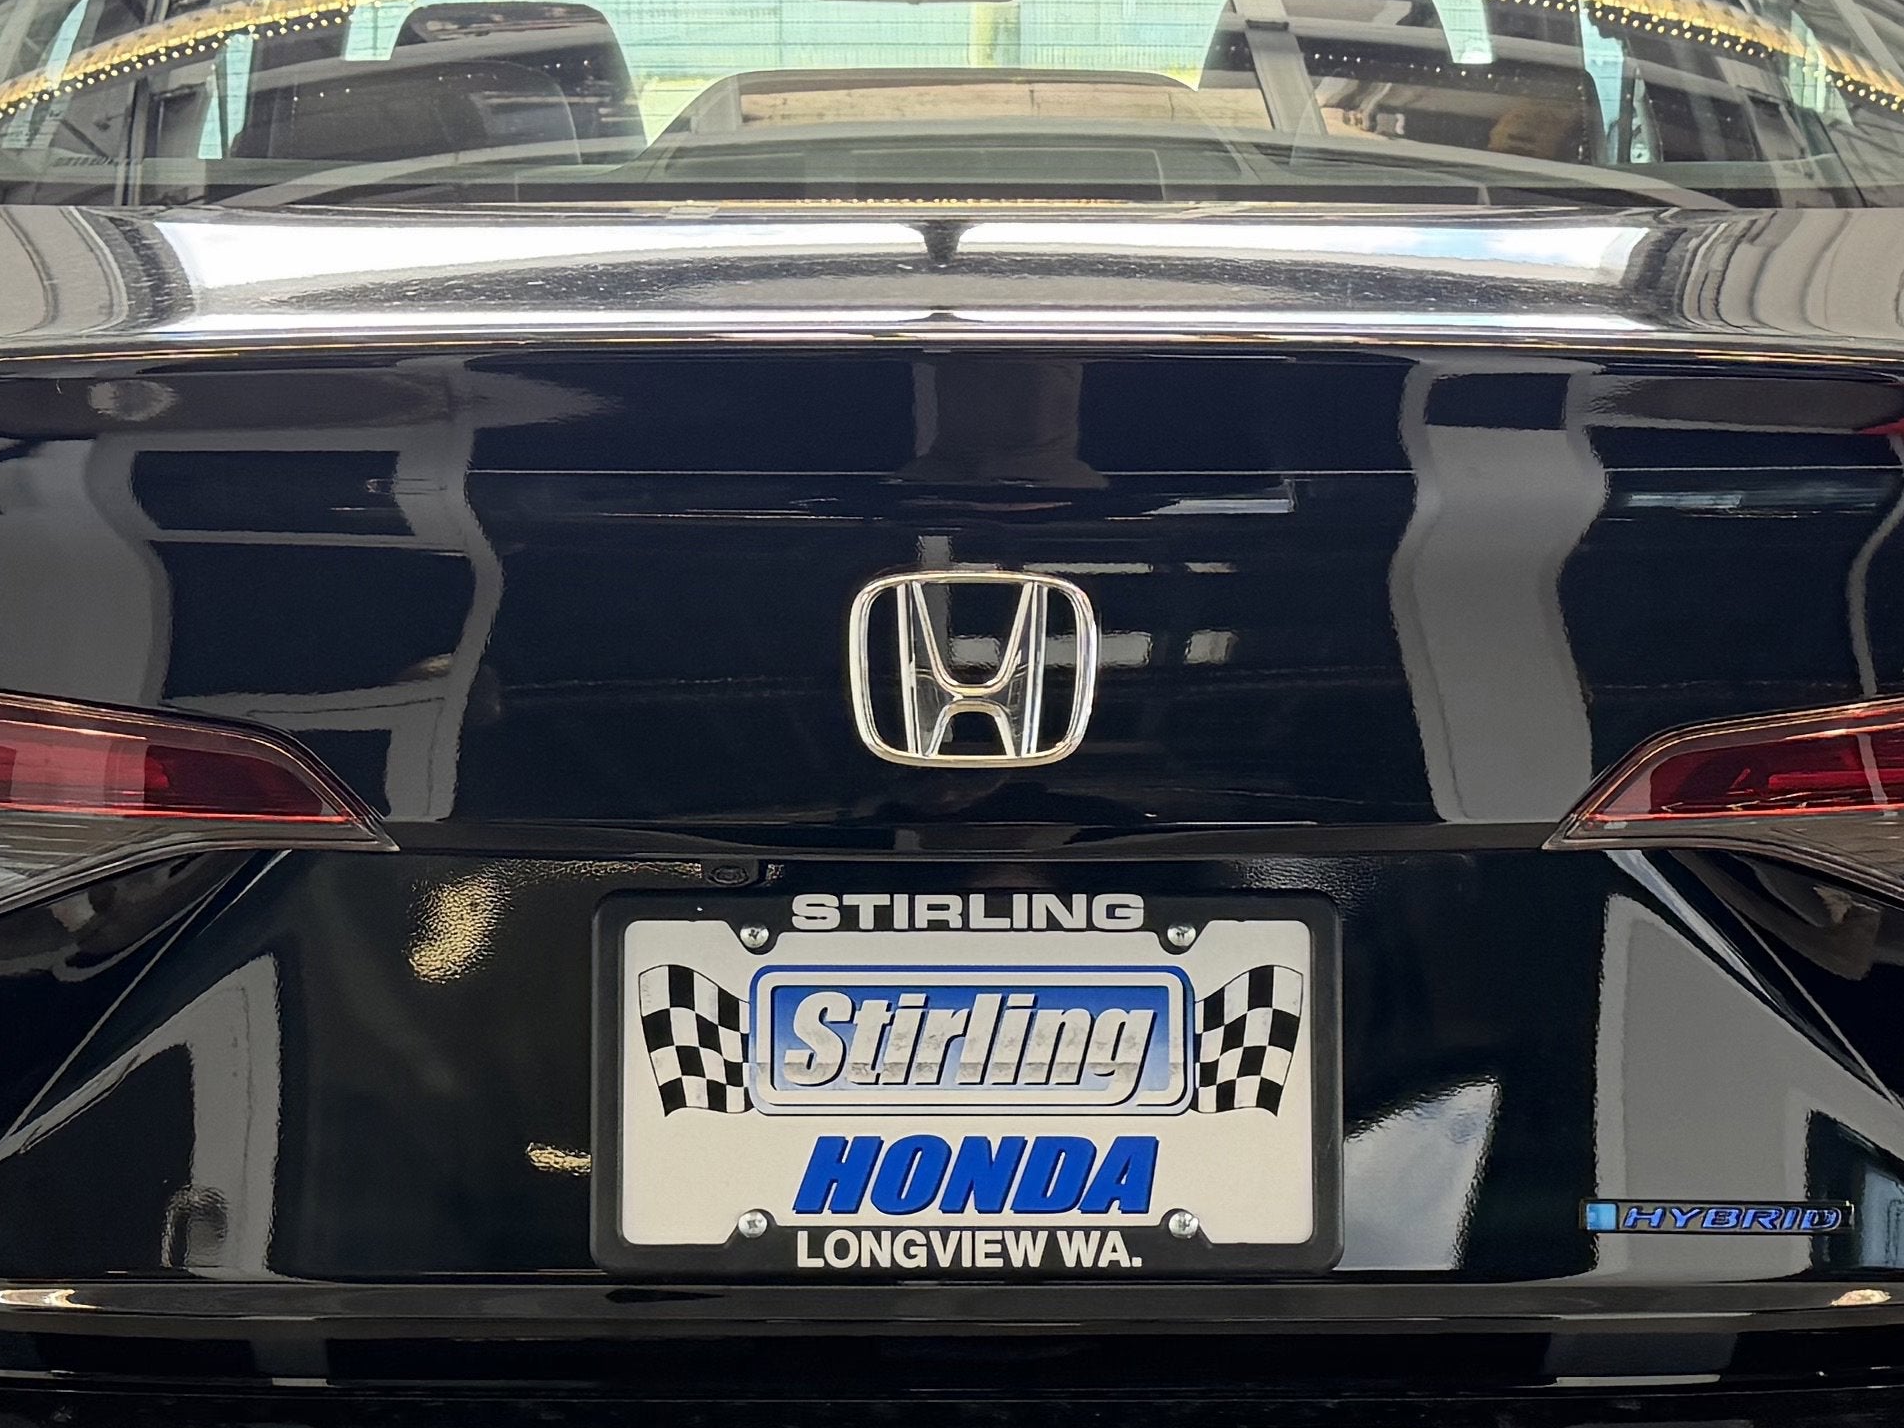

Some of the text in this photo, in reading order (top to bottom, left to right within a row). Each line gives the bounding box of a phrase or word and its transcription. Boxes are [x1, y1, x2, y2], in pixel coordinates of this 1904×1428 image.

[791, 893, 1146, 931] STIRLING
[783, 990, 1157, 1102] Stirling
[792, 1135, 1159, 1216] HONDA
[1622, 1206, 1843, 1232] HYBRID
[796, 1230, 1143, 1269] LONGVIEW WA.
